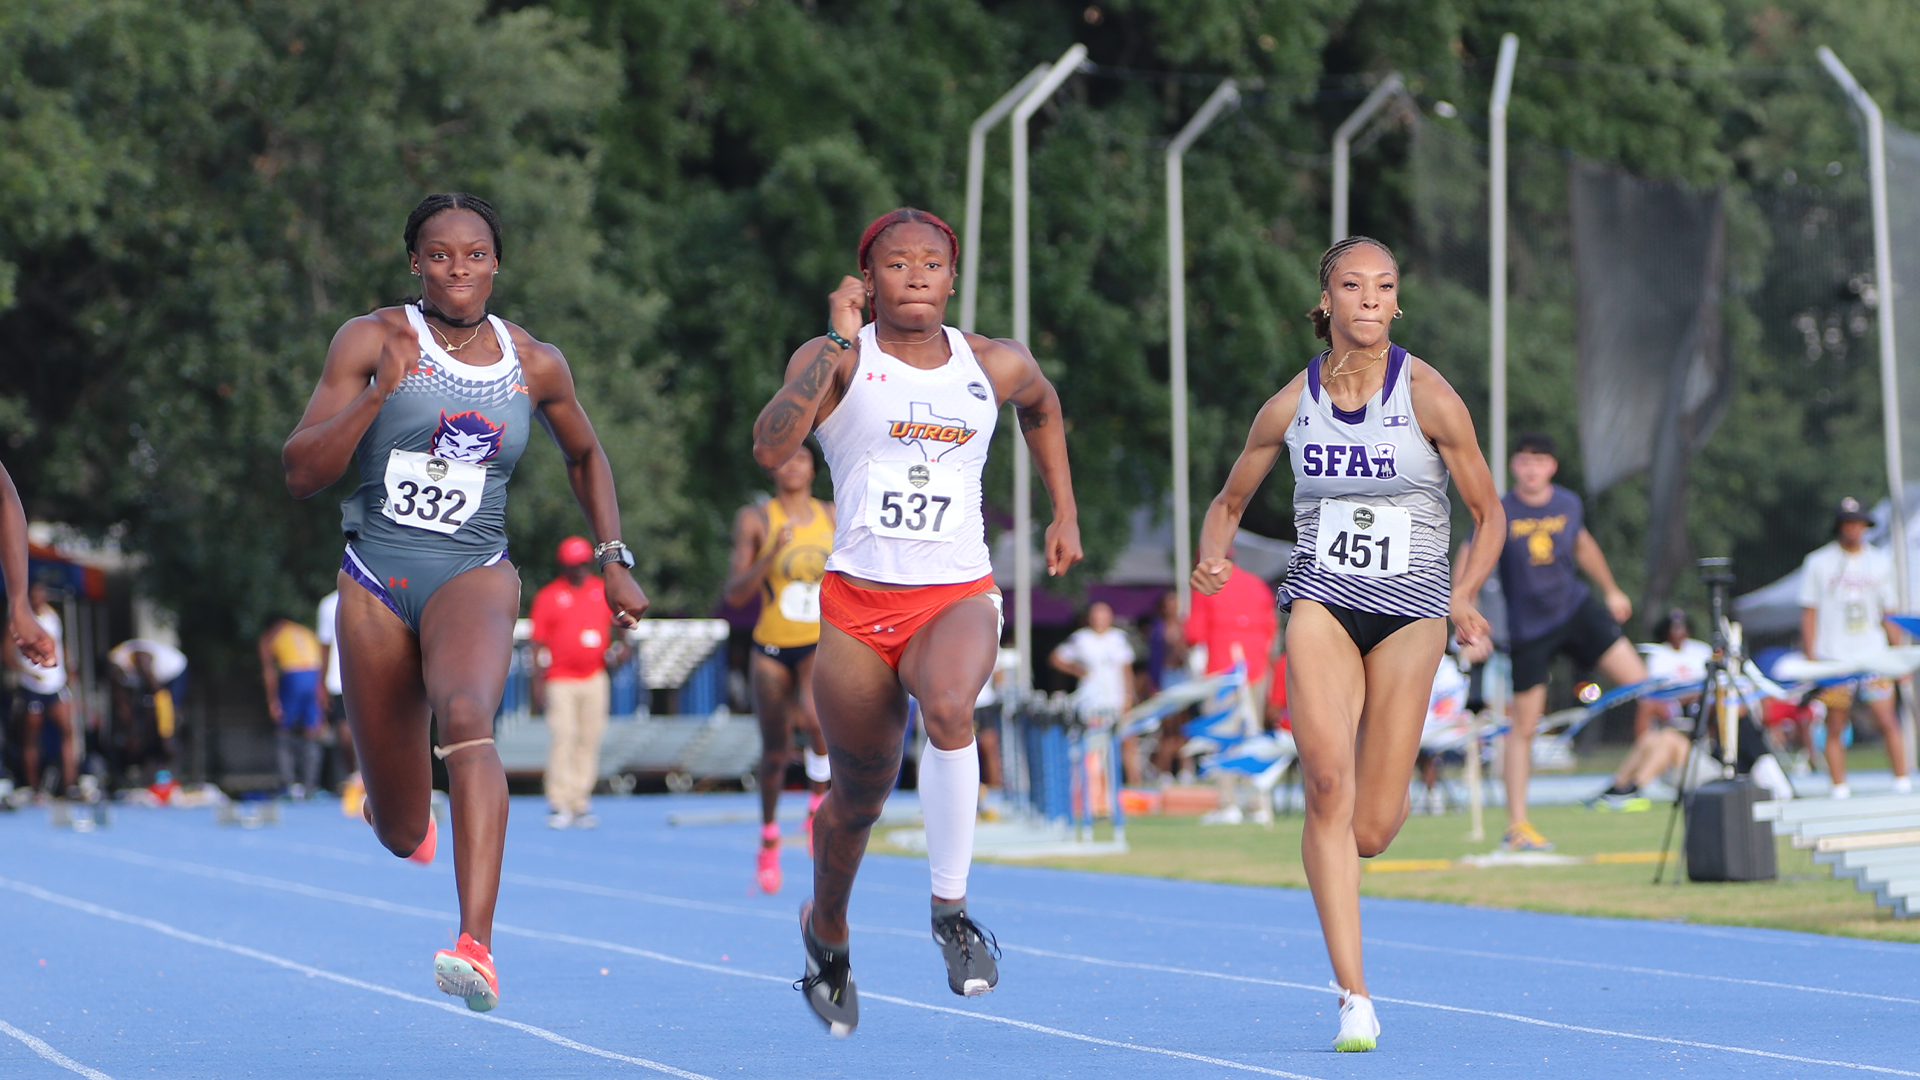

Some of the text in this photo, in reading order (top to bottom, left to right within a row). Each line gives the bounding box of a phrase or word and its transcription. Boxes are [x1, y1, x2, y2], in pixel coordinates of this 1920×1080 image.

[889, 420, 977, 446] UTRGV
[1303, 443, 1372, 477] SFA
[393, 480, 467, 527] 332
[879, 490, 951, 533] 537
[1328, 531, 1391, 571] 451
